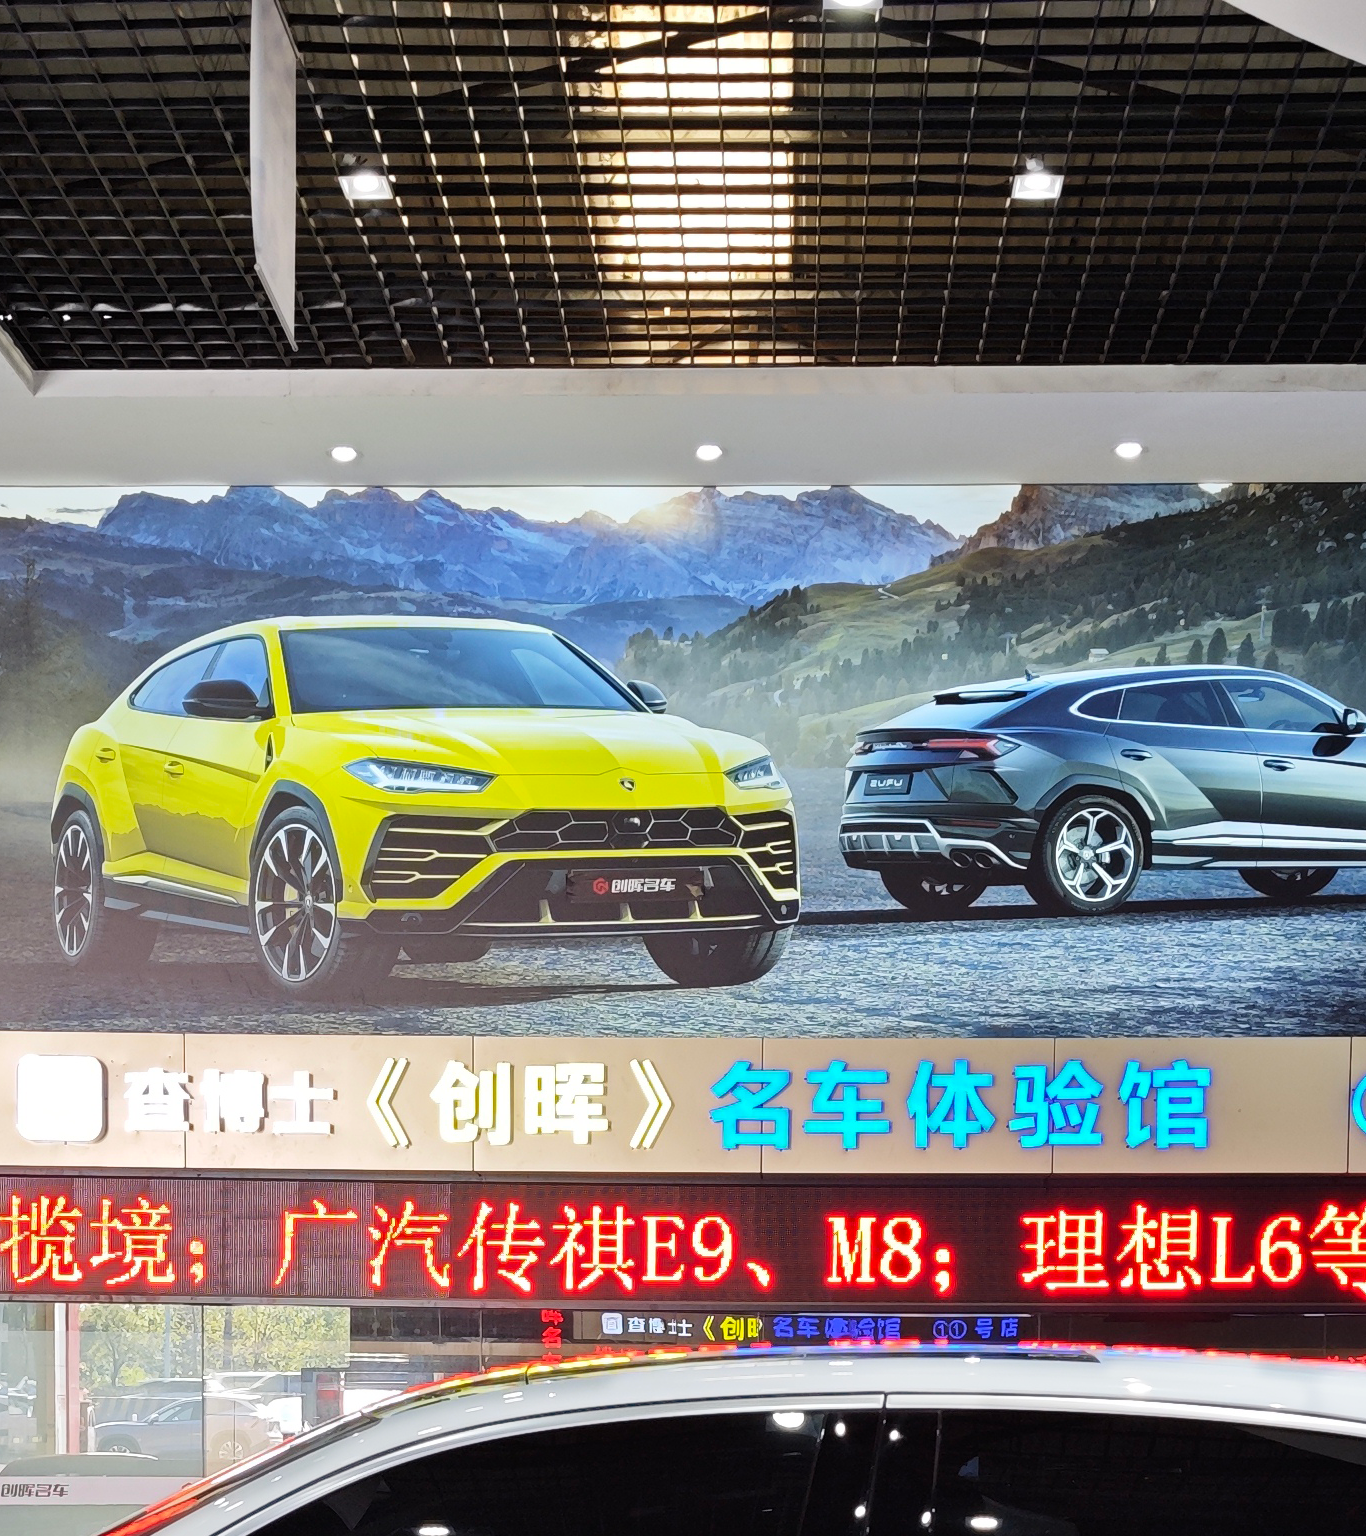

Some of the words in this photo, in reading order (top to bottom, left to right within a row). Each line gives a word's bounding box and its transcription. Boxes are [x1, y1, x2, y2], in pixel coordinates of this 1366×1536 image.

[611, 878, 676, 893] 创晖名车
[1, 1483, 70, 1497] 创晖名车
